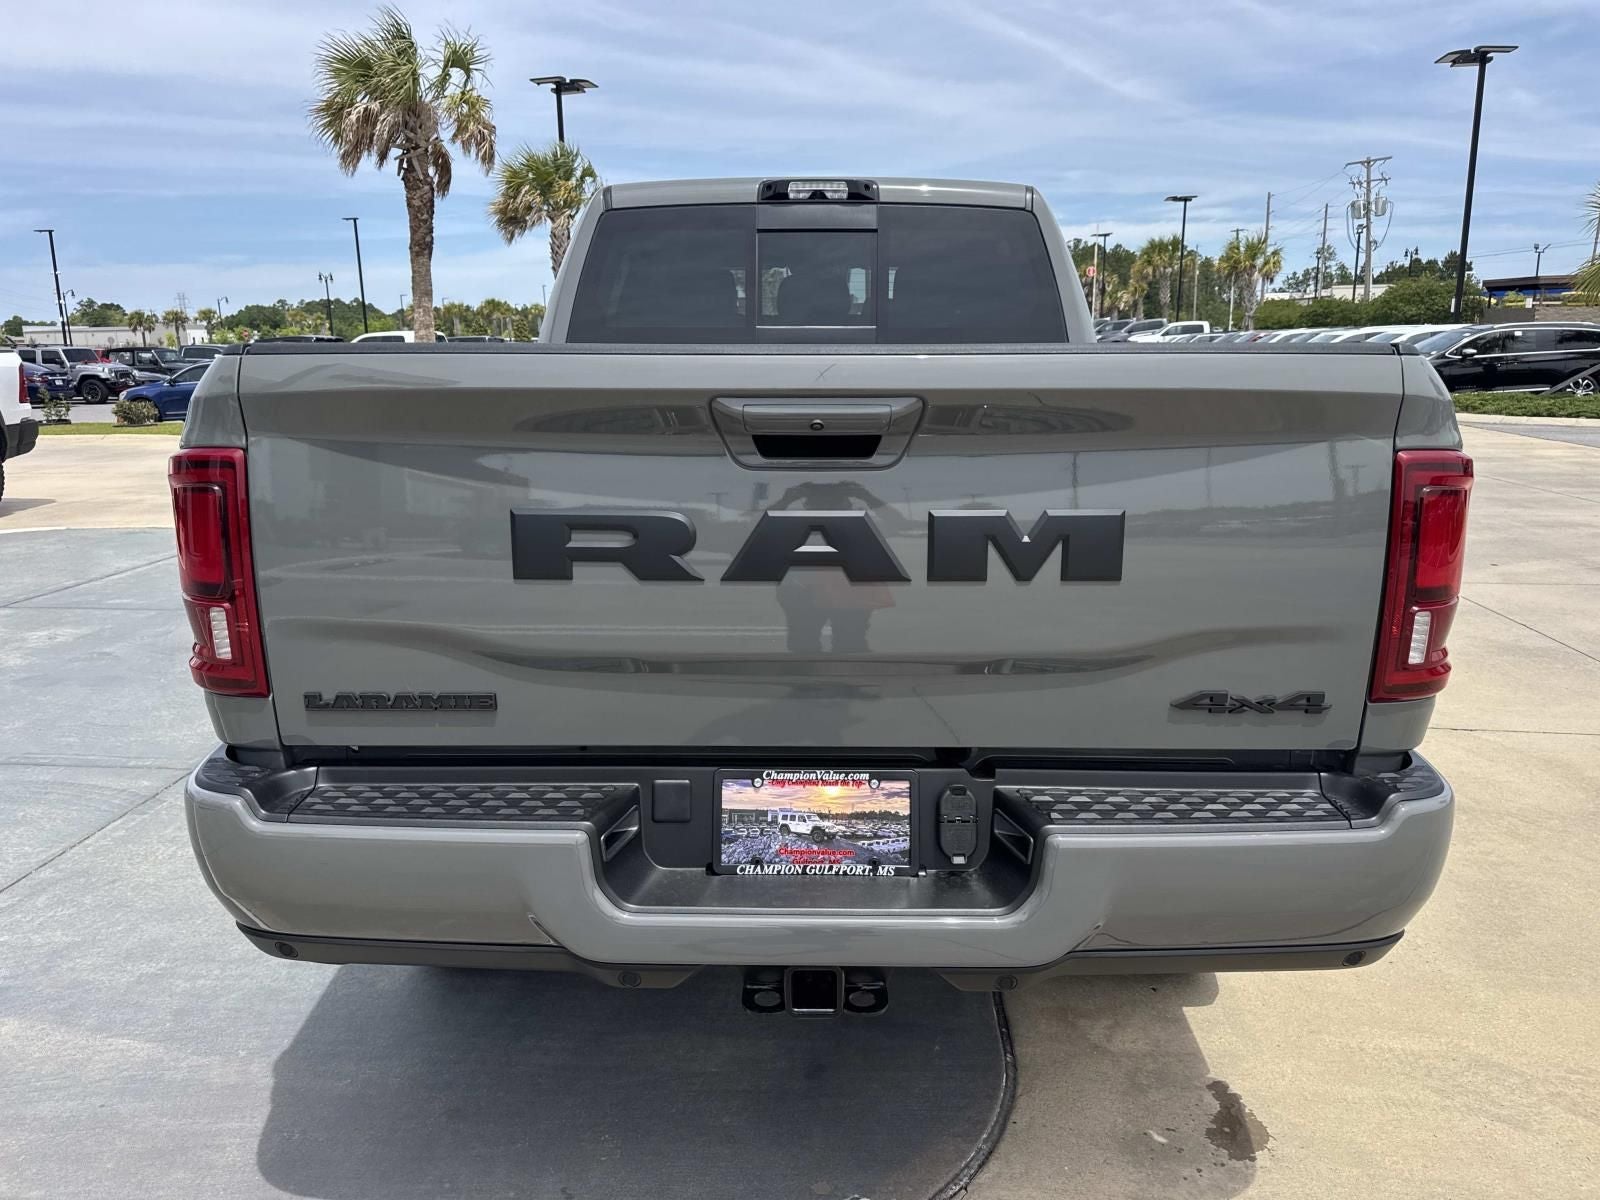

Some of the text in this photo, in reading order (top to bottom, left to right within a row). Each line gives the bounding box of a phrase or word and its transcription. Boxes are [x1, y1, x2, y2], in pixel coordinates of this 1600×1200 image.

[510, 509, 1126, 581] RAM
[303, 692, 497, 711] LARAMIE
[1170, 690, 1332, 713] 4x4
[763, 770, 870, 782] ChampionValue.com
[779, 848, 855, 856] Championvalue.com
[736, 864, 895, 877] CHAMPION GULFPORT, MS
